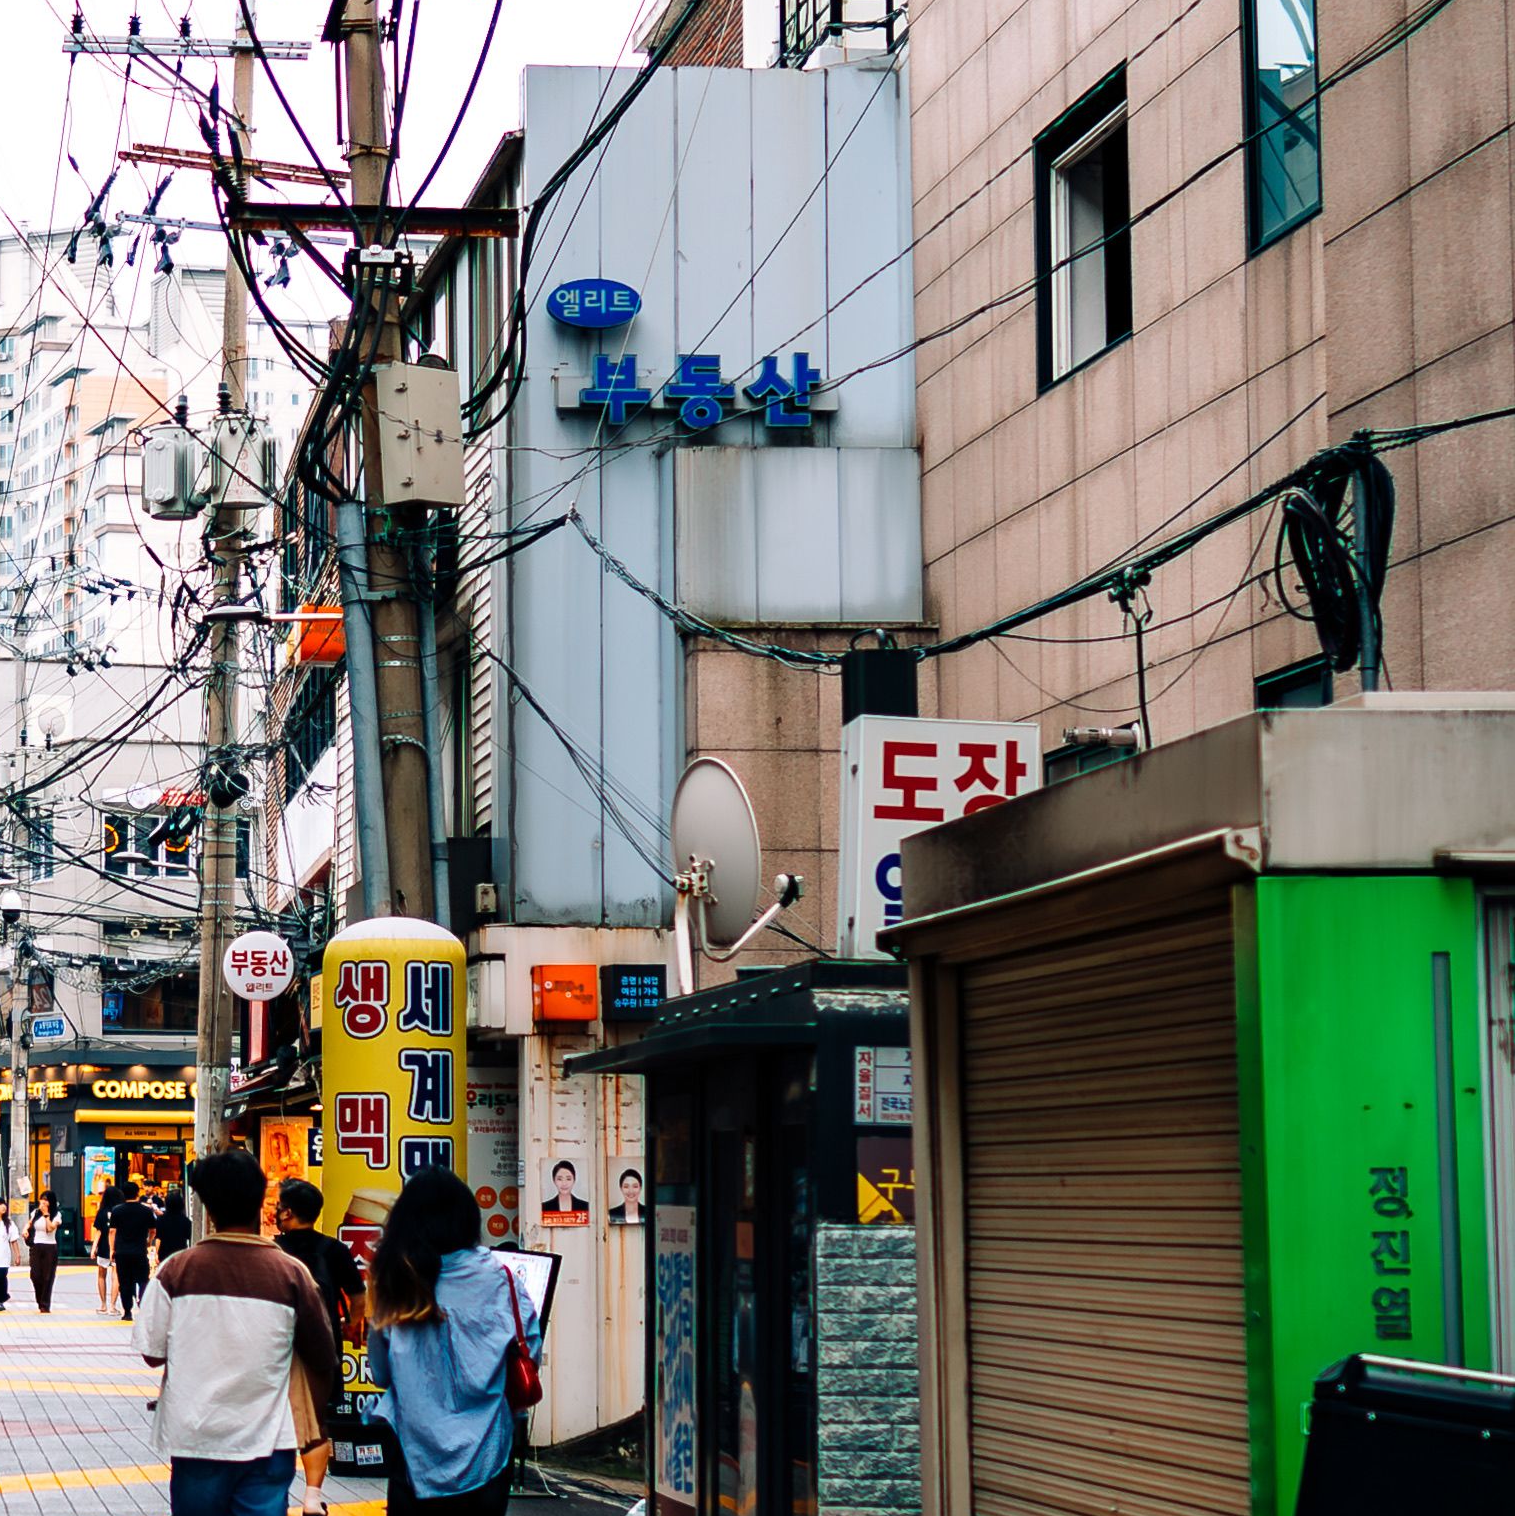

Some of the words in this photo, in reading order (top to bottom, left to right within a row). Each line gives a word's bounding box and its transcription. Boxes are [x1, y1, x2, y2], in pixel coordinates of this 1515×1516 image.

[556, 288, 637, 317] 엘리트
[580, 351, 829, 429] 부동산
[873, 740, 1027, 822] 도장
[231, 950, 288, 977] 부동산
[614, 998, 637, 1008] 승무원
[644, 998, 664, 1008] 프로
[92, 1079, 186, 1100] COMPOSE
[858, 1051, 872, 1119] 자율질서
